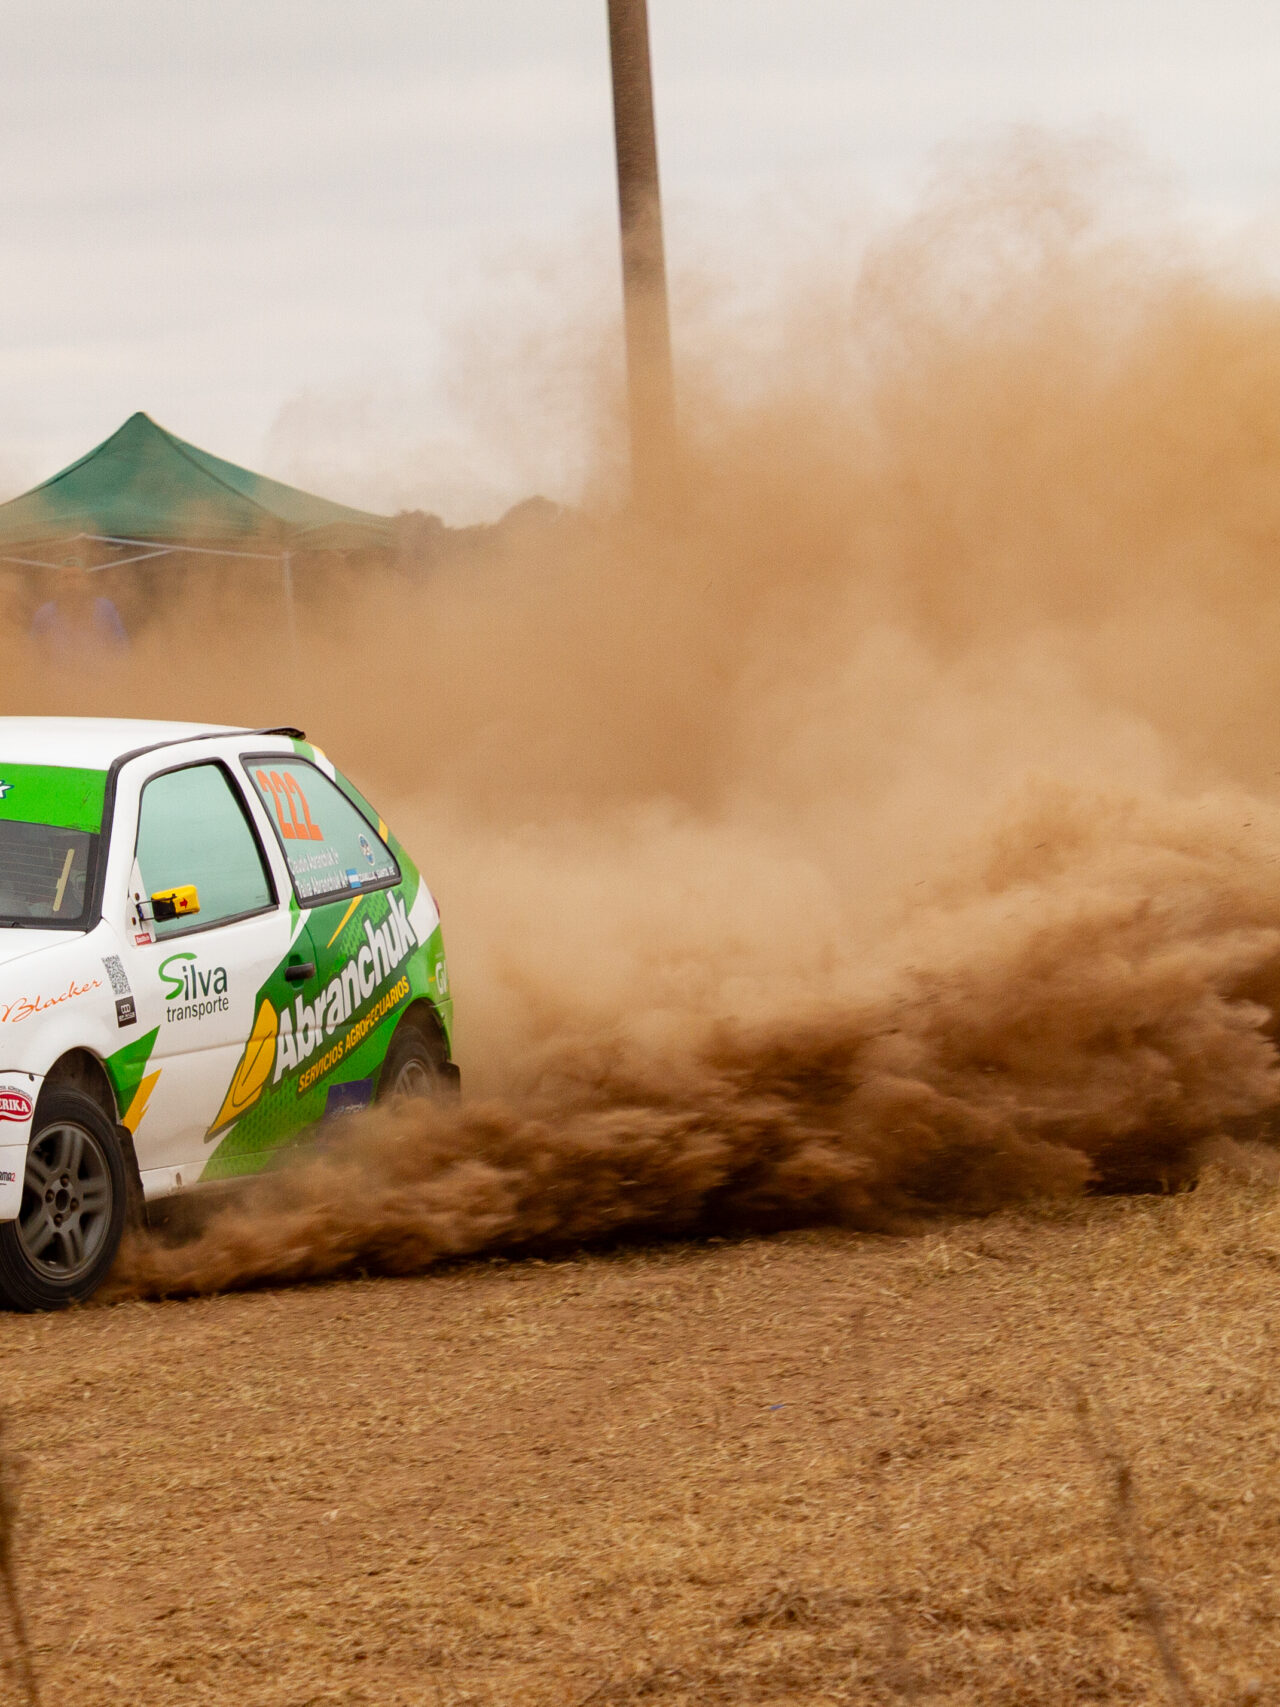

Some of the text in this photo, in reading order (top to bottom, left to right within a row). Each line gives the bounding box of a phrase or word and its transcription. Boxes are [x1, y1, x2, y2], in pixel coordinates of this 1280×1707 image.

[255, 769, 324, 841] 222
[1, 979, 102, 1023] Blacker
[158, 952, 228, 1000] Silva
[272, 891, 417, 1084] Abranchuk
[166, 996, 229, 1022] transporte
[298, 1040, 344, 1092] SERVICIOS
[345, 975, 410, 1053] AGROPECUARIOS
